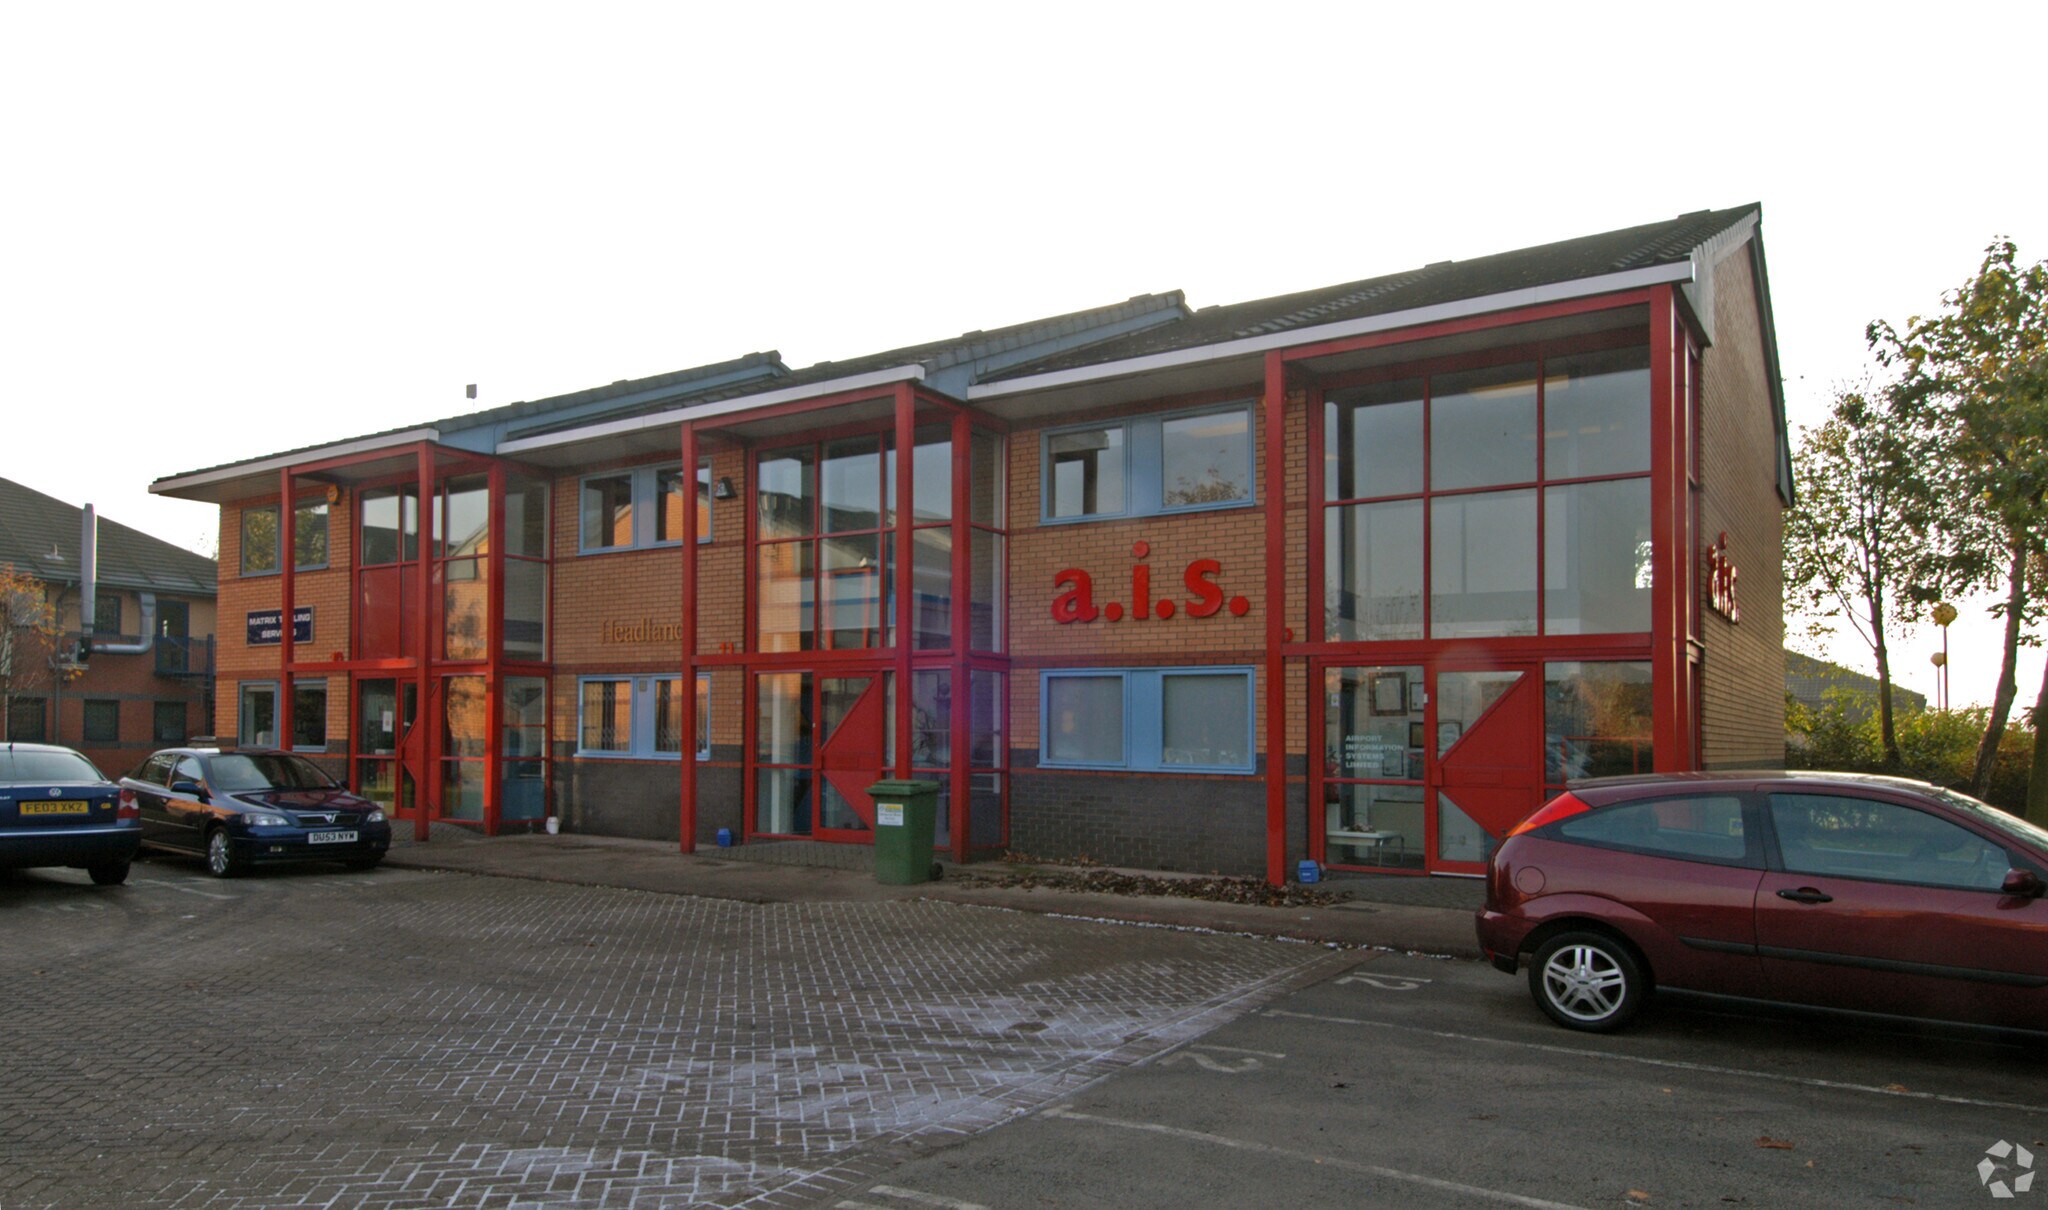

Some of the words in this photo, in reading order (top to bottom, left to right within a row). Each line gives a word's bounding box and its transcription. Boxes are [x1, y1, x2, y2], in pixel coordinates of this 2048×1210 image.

[1051, 540, 1250, 624] a.i.s.
[249, 616, 277, 626] MATRIX
[278, 612, 311, 624] TLING
[26, 803, 58, 813] FE03
[61, 802, 84, 812] XKZ
